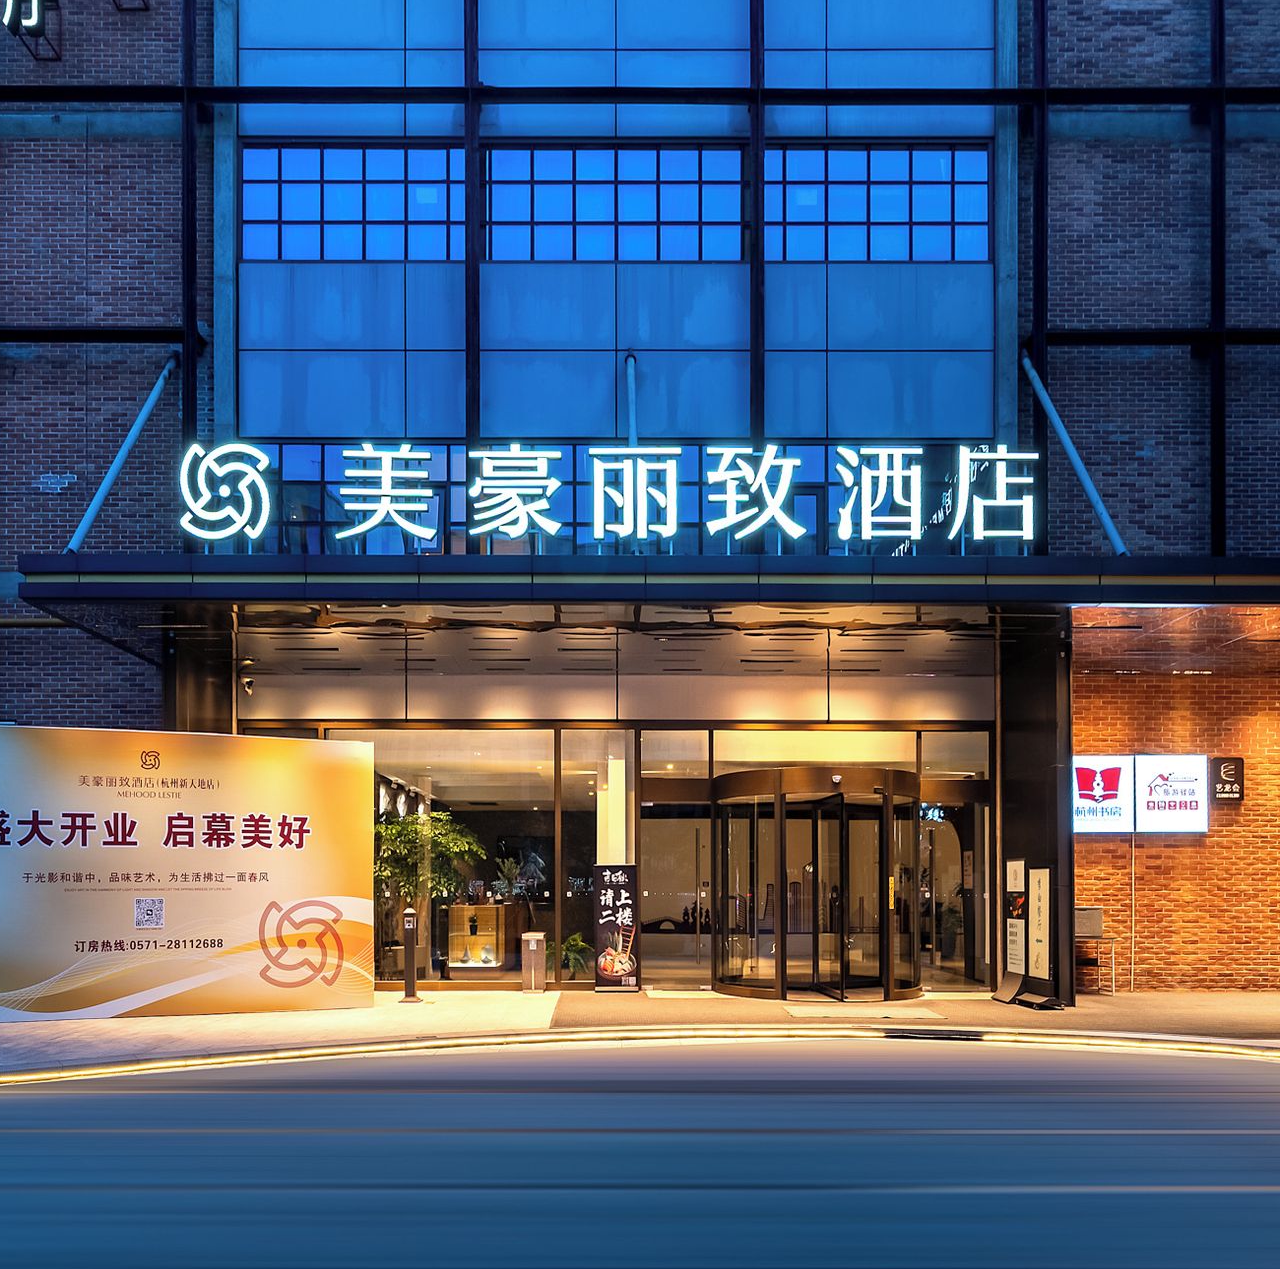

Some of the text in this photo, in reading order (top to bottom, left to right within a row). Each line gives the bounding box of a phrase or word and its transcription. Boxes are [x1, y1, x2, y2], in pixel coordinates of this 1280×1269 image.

[333, 442, 1040, 541] 美豪丽致酒店
[117, 790, 156, 798] MEHOOD
[163, 813, 312, 849] 启幕美好
[600, 888, 632, 907] 请上
[74, 939, 224, 954] 订房热线:0571-28112688
